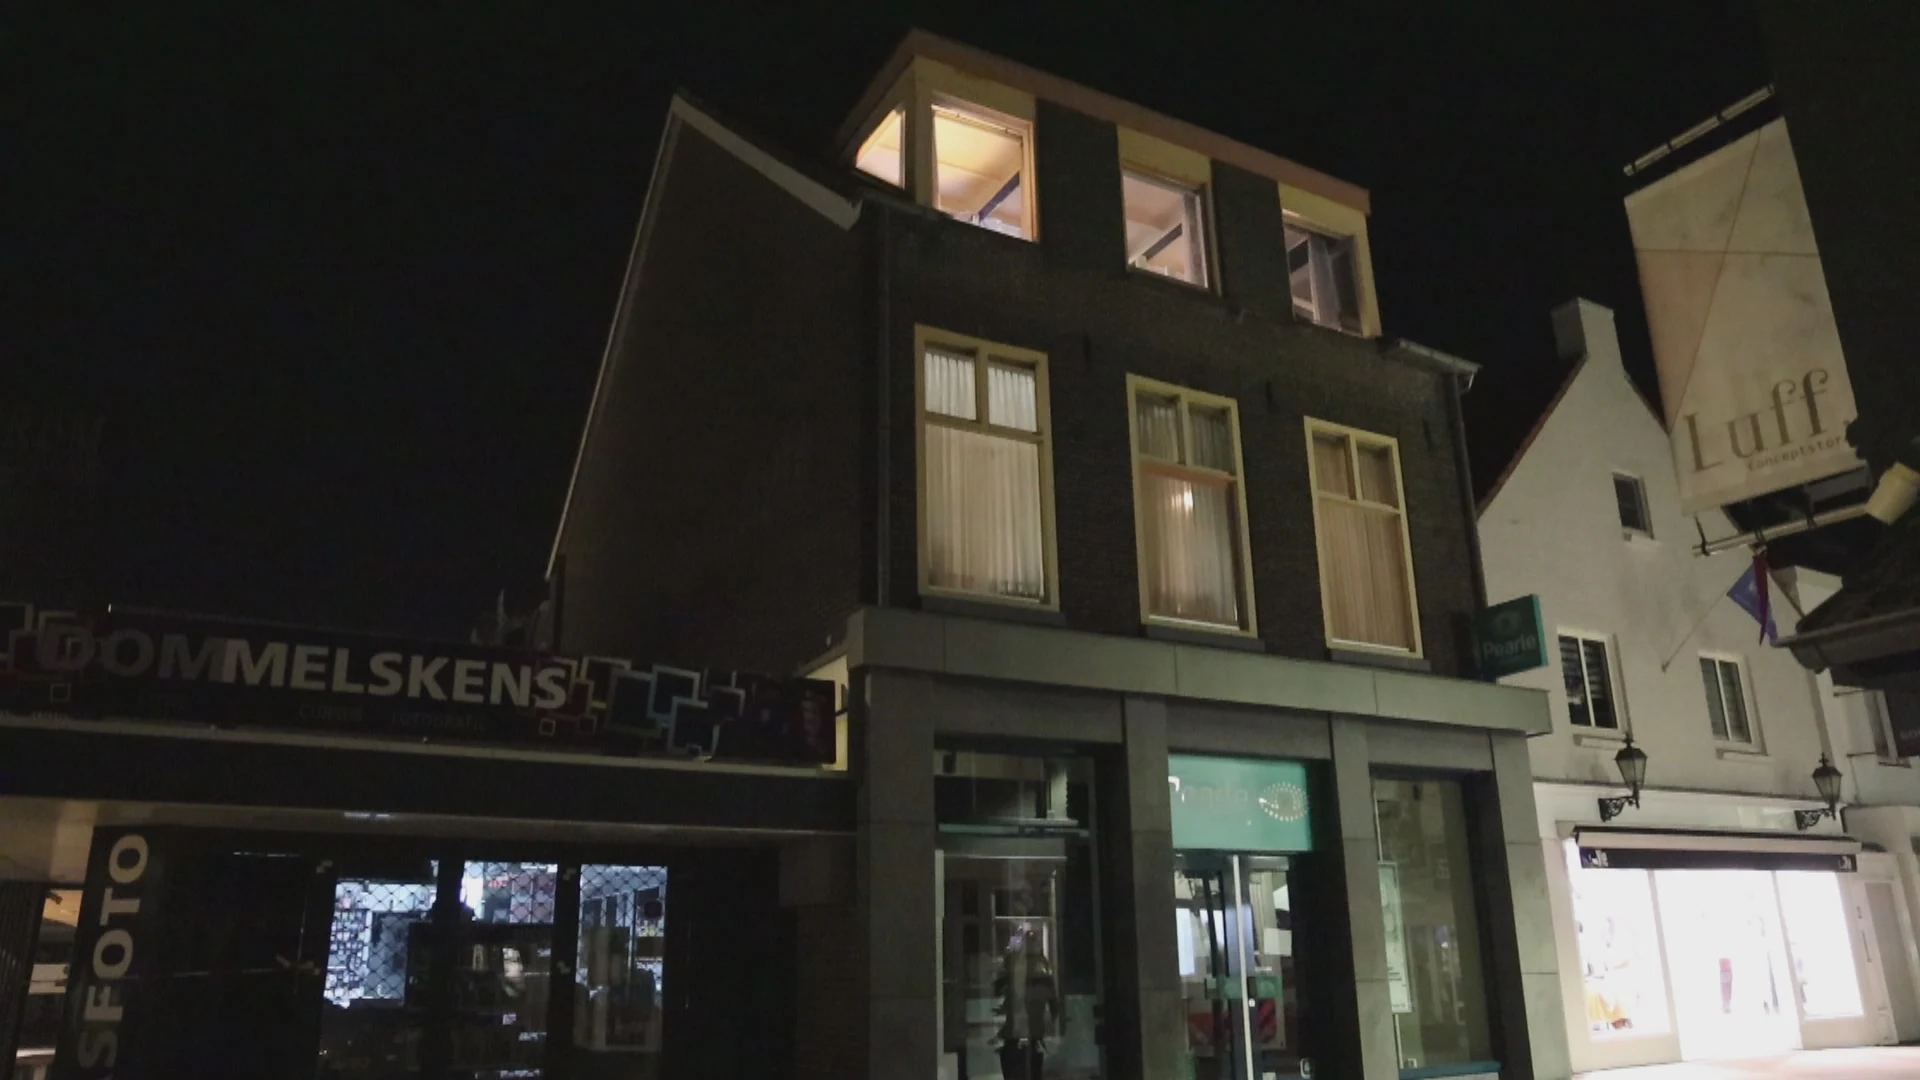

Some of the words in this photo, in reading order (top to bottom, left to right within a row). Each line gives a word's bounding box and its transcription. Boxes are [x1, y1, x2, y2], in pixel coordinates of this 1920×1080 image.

[1684, 368, 1828, 472] Luff
[1749, 435, 1846, 472] Conceptstor
[35, 623, 568, 709] DOMMELSKENS
[1482, 633, 1537, 660] Pearle
[77, 833, 149, 1080] SFOTO
